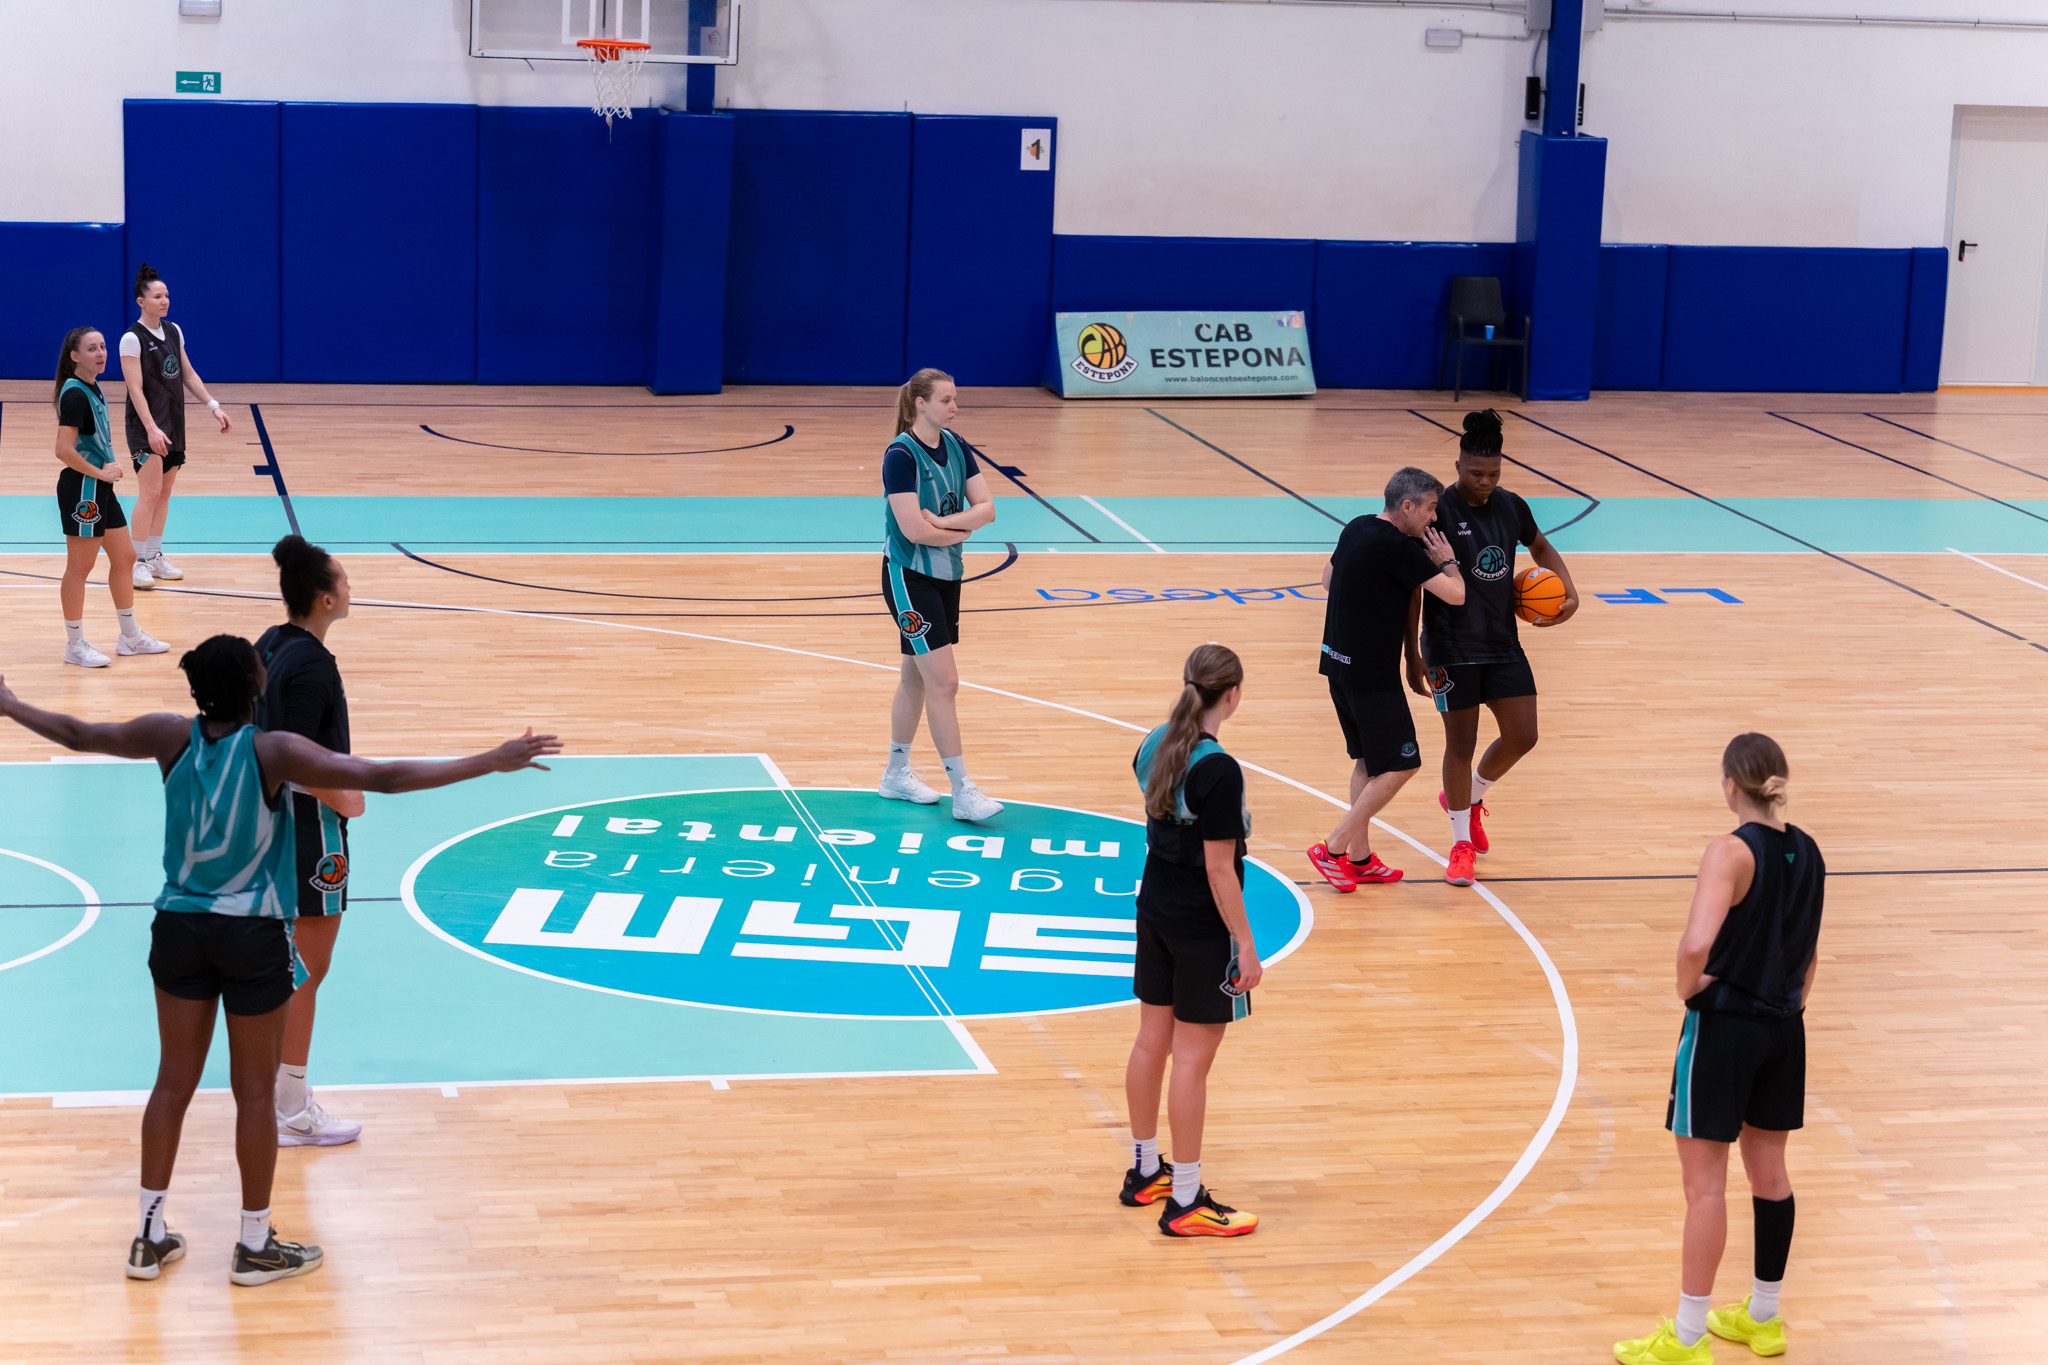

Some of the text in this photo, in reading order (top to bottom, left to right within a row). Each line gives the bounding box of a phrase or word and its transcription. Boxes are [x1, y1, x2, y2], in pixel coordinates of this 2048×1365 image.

[1194, 323, 1253, 343] CAB
[1150, 347, 1306, 368] ESTEPONA
[1075, 361, 1135, 380] ESTEPONA
[1165, 375, 1299, 384] www.baloncestoestepona.com
[1474, 567, 1507, 578] ESTEPONA
[1035, 588, 1328, 605] ndesa
[551, 814, 1148, 859] mbiental
